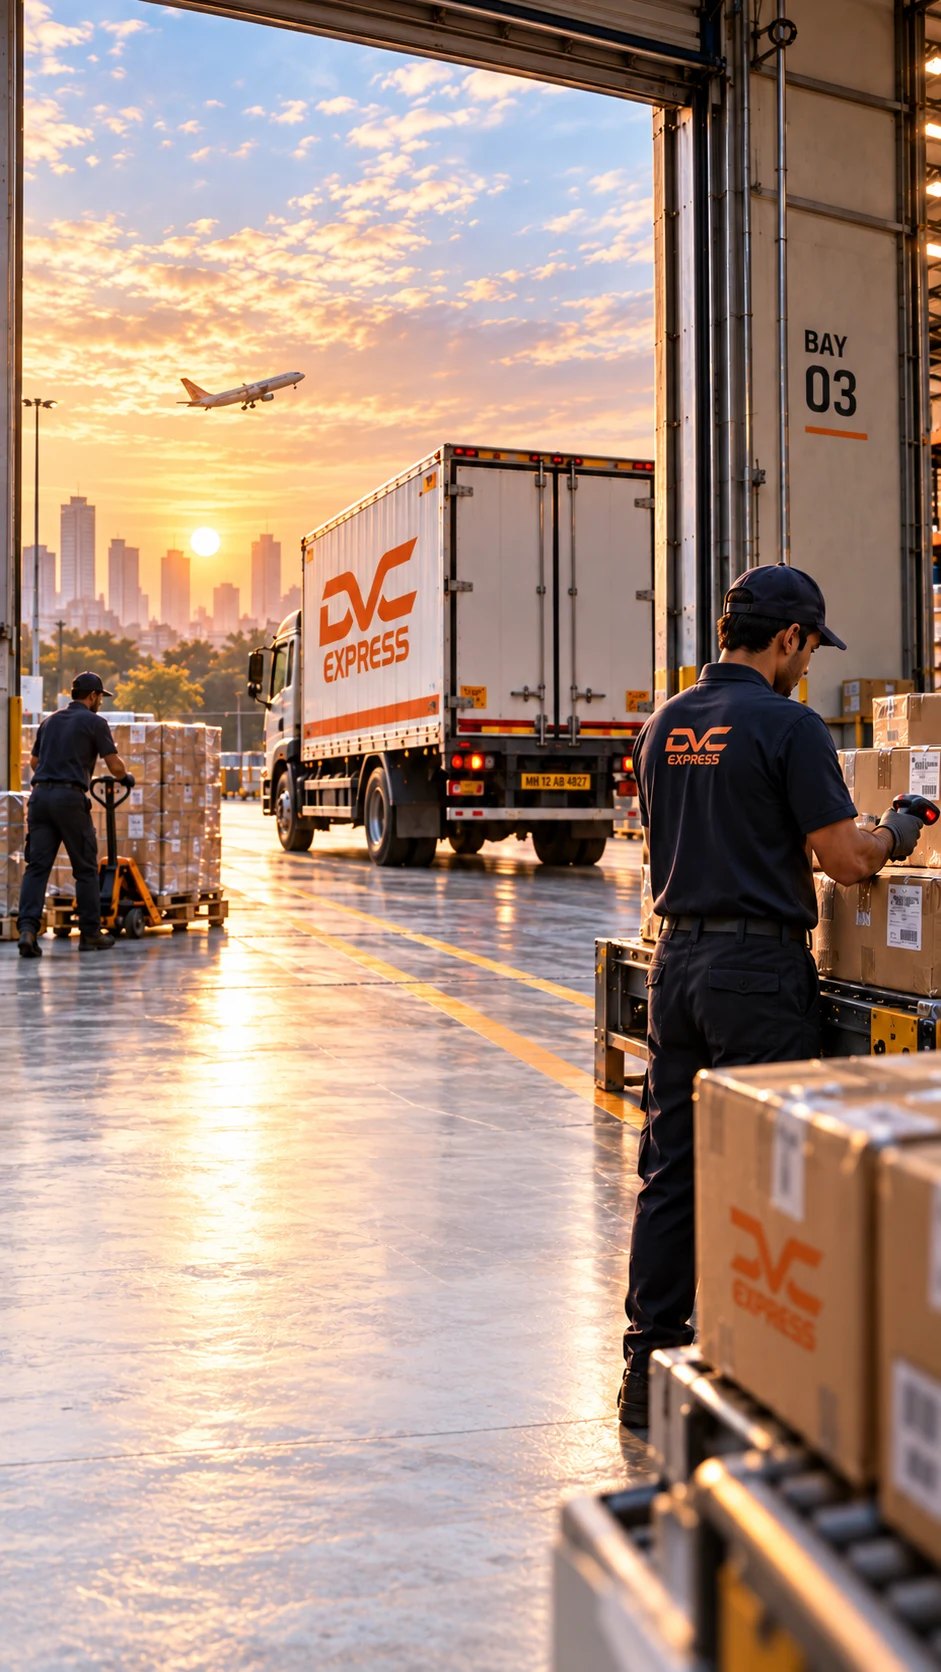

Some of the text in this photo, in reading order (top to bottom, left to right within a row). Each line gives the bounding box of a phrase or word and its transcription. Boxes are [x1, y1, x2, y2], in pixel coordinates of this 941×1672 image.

[805, 329, 848, 358] BAY
[805, 365, 857, 417] 03
[319, 536, 418, 647] DVC
[323, 625, 410, 684] EXPRESS
[665, 726, 733, 752] DVC
[667, 753, 720, 765] EXPRESS
[525, 776, 588, 787] MH 12 AB 4827
[732, 1278, 817, 1354] EXPRESS
